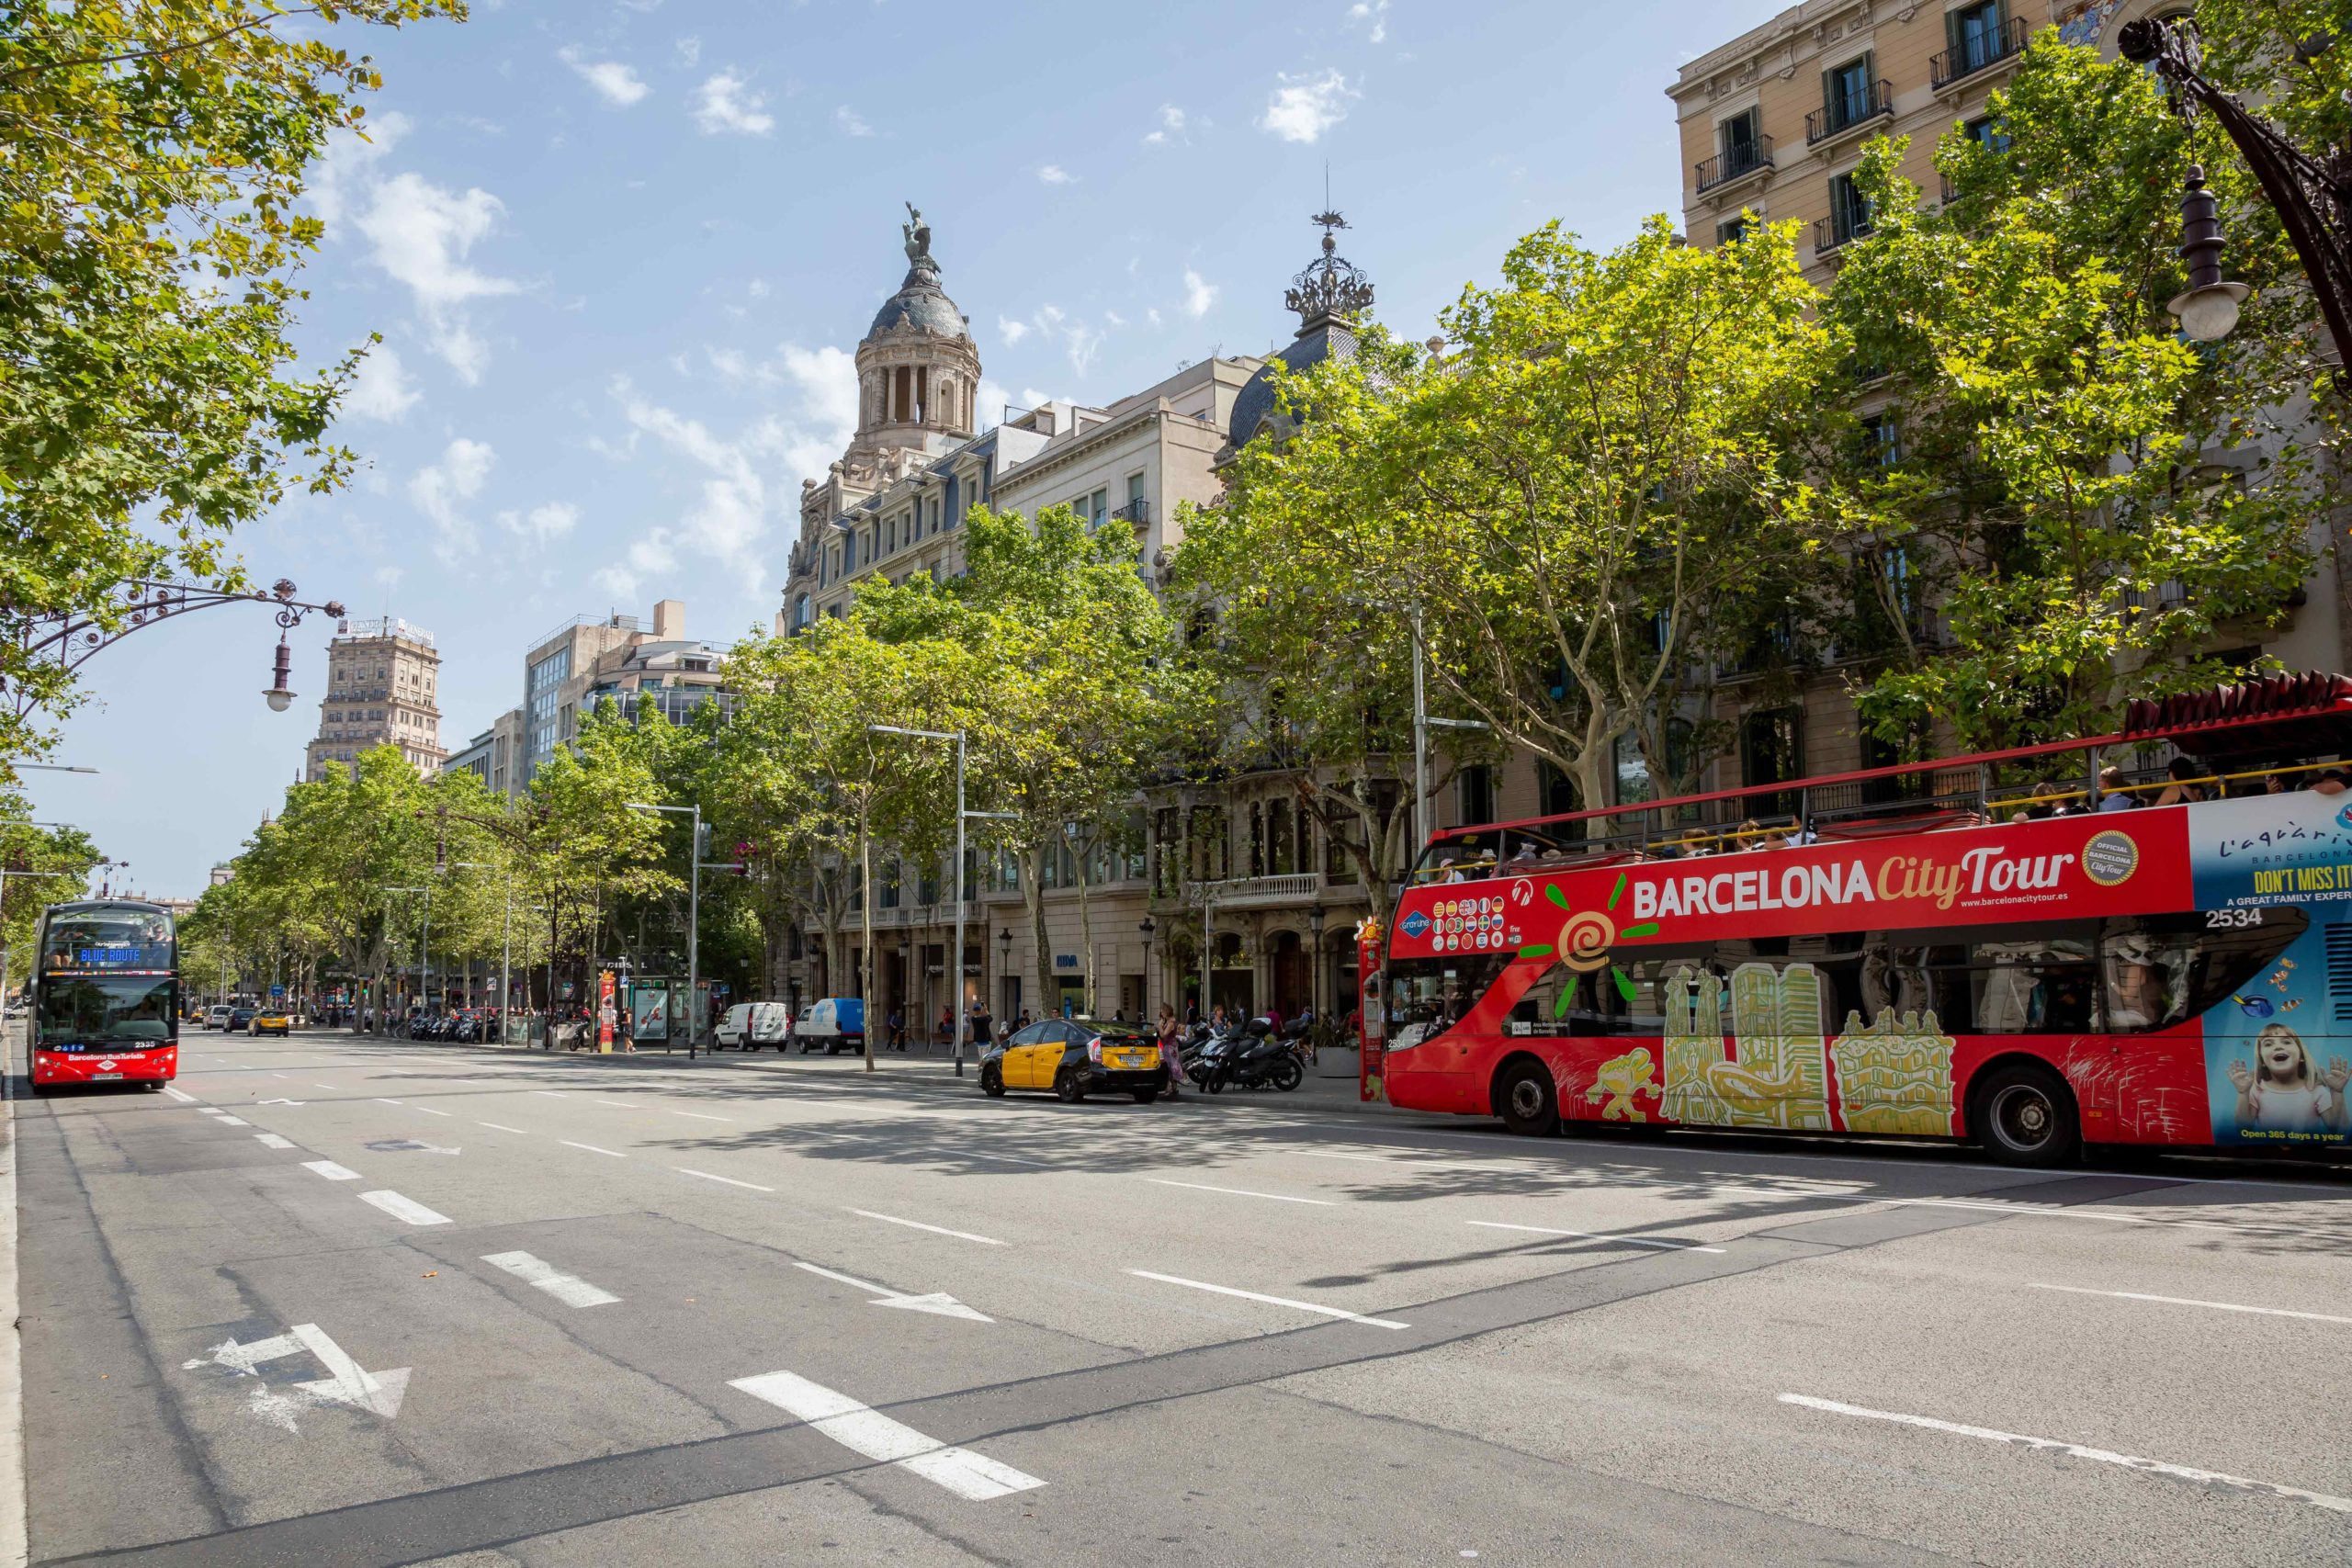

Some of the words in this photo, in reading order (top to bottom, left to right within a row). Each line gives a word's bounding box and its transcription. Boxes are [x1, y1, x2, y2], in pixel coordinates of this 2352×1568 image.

[2097, 842, 2128, 853] OFFICIAL
[2088, 852, 2132, 865] BARCELONA
[1634, 860, 1875, 919] BARCELONA
[1876, 856, 1965, 910] City
[1961, 845, 2075, 894] Tour
[2254, 869, 2294, 895] DON'T
[2298, 866, 2335, 891] MISS
[1961, 893, 2068, 908] www.barcelonacitytour.es
[2236, 896, 2271, 906] GREAT
[2273, 893, 2312, 904] FAMILY
[2206, 908, 2262, 928] 2534
[81, 949, 106, 962] BLUE
[108, 949, 140, 962] ROUTE
[1057, 955, 1078, 967] BBVA
[1388, 1039, 1405, 1048] 2534
[2241, 1129, 2267, 1139] Open
[2267, 1130, 2286, 1139] 365
[2288, 1131, 2311, 1141] days
[2322, 1133, 2345, 1142] year
